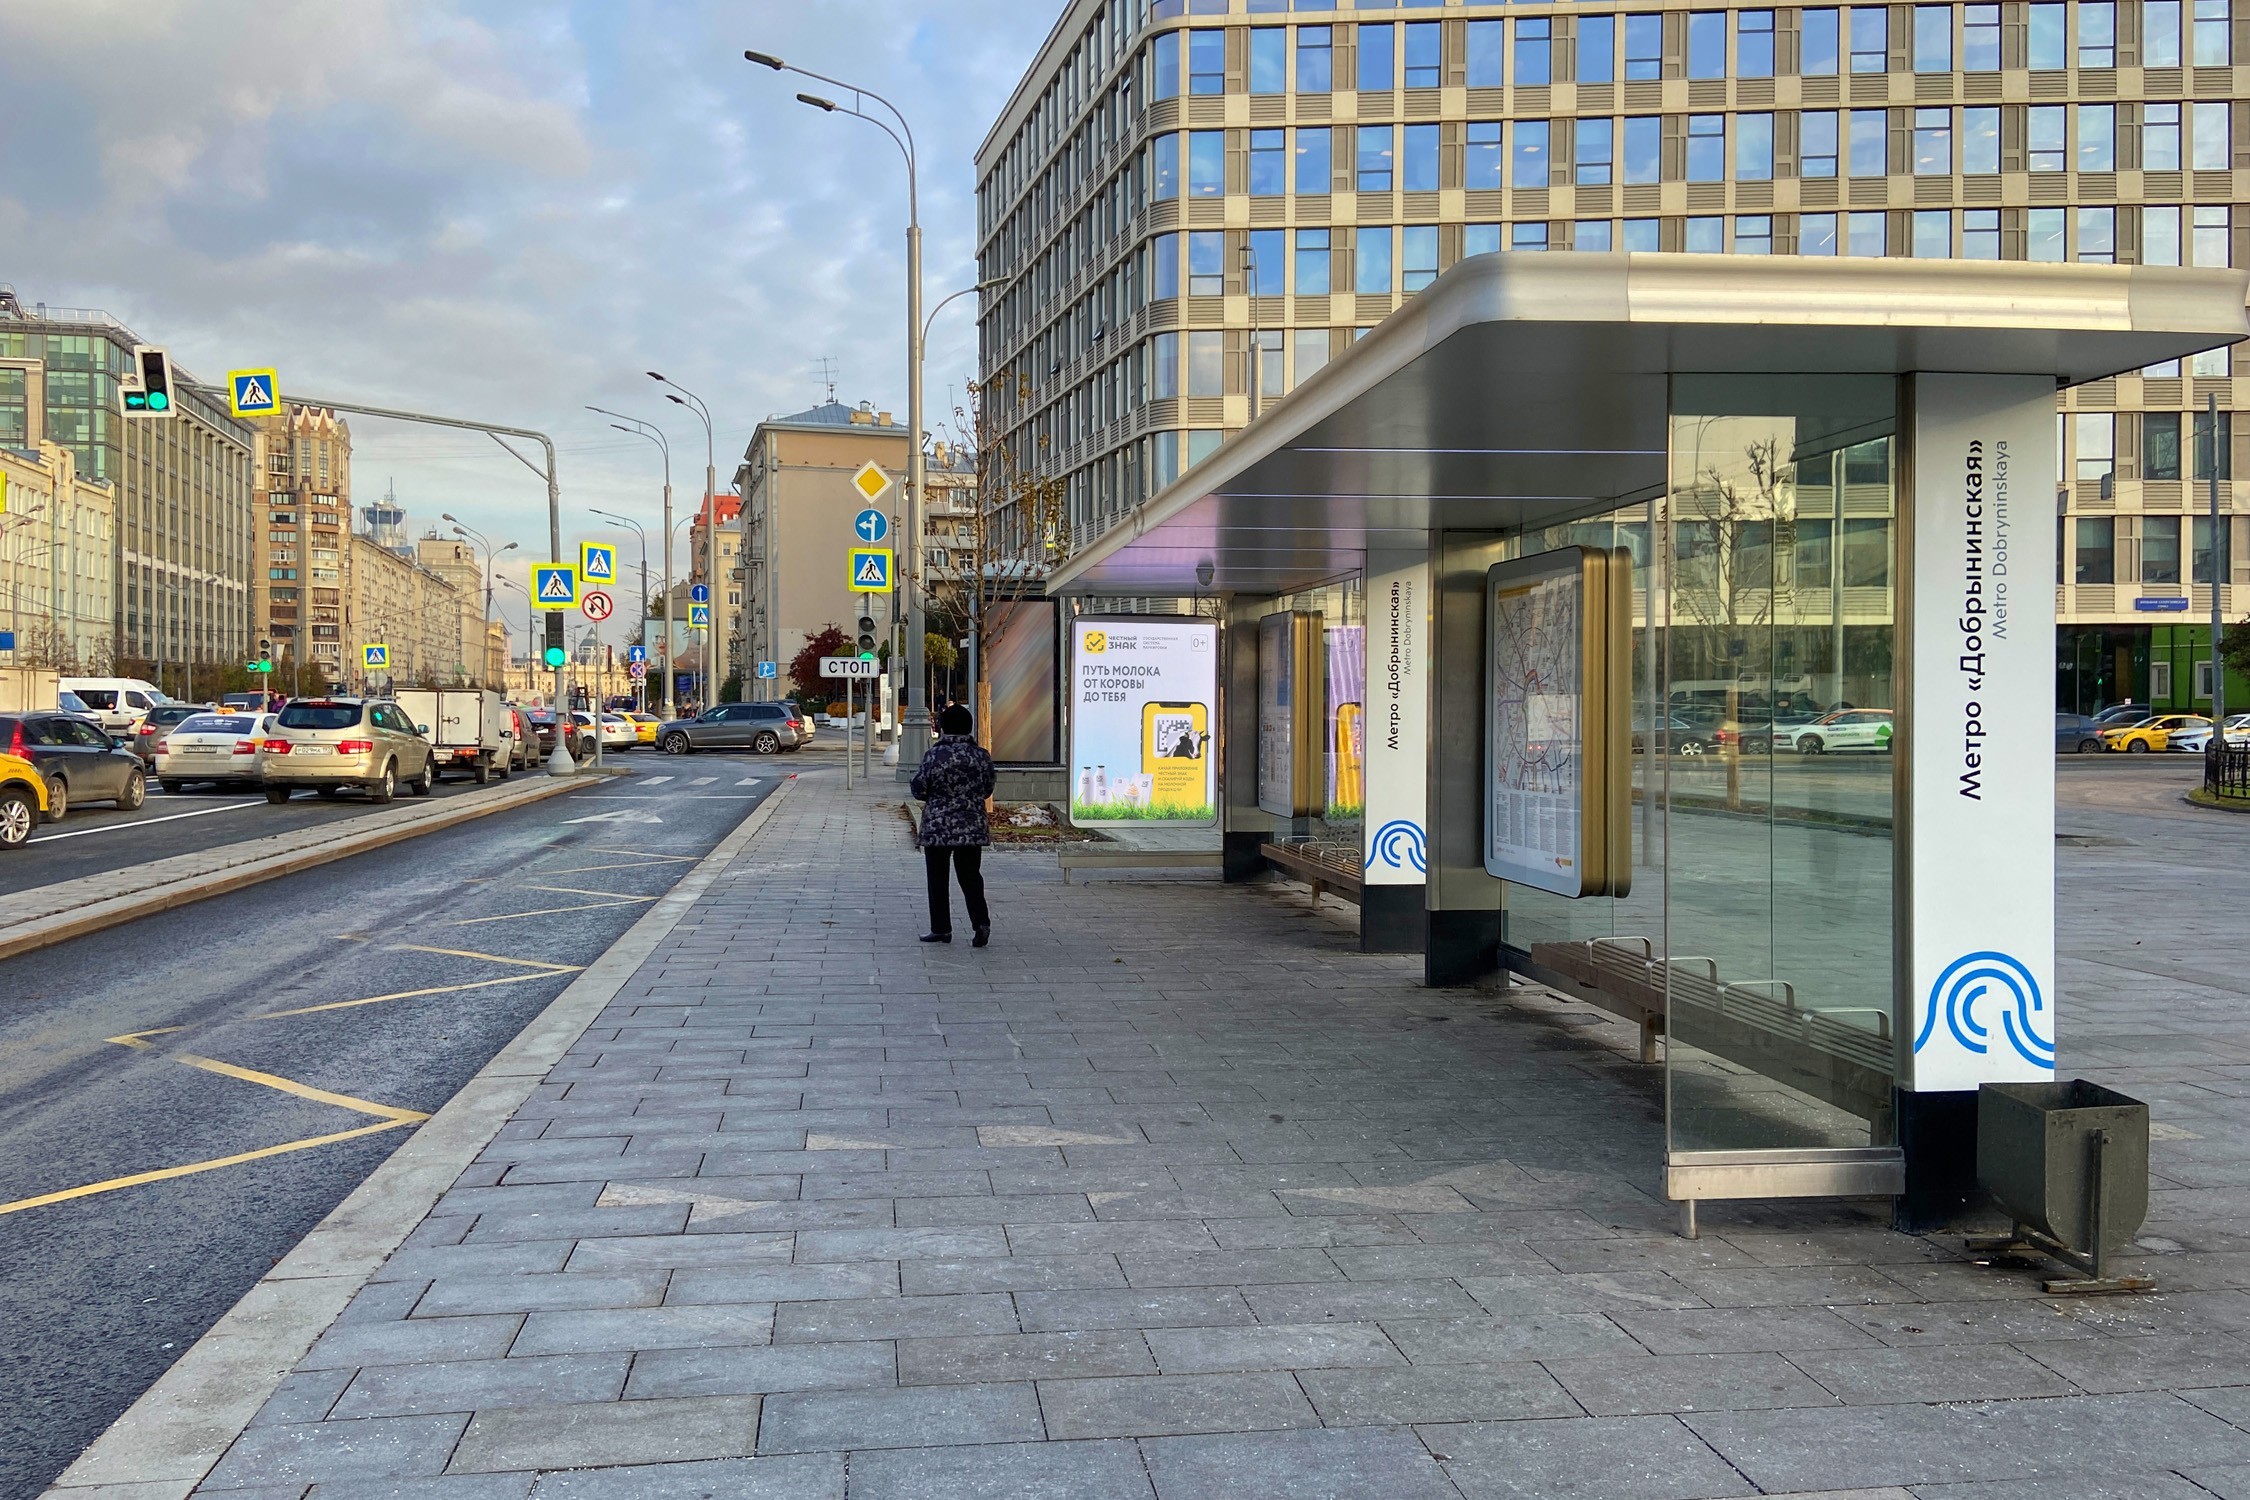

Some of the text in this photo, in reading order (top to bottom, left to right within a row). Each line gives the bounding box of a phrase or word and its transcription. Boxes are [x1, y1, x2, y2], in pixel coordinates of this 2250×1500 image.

[1992, 440, 2011, 640] Metro Dobryninskaya
[1959, 439, 1986, 801] Метро «Добрынинская»
[1403, 581, 1412, 675] Metro Dobryninskaya
[1108, 642, 1137, 650] ЗНАК
[1192, 638, 1206, 648] 0+
[828, 661, 870, 674] СТОП
[1082, 665, 1161, 676] ПУТЬ МОЛОКА
[1387, 581, 1401, 750] Метро «Добрынинская»
[1083, 678, 1145, 689] ОТ КОРОВЫ
[1083, 692, 1126, 703] ДО ТЕБЯ
